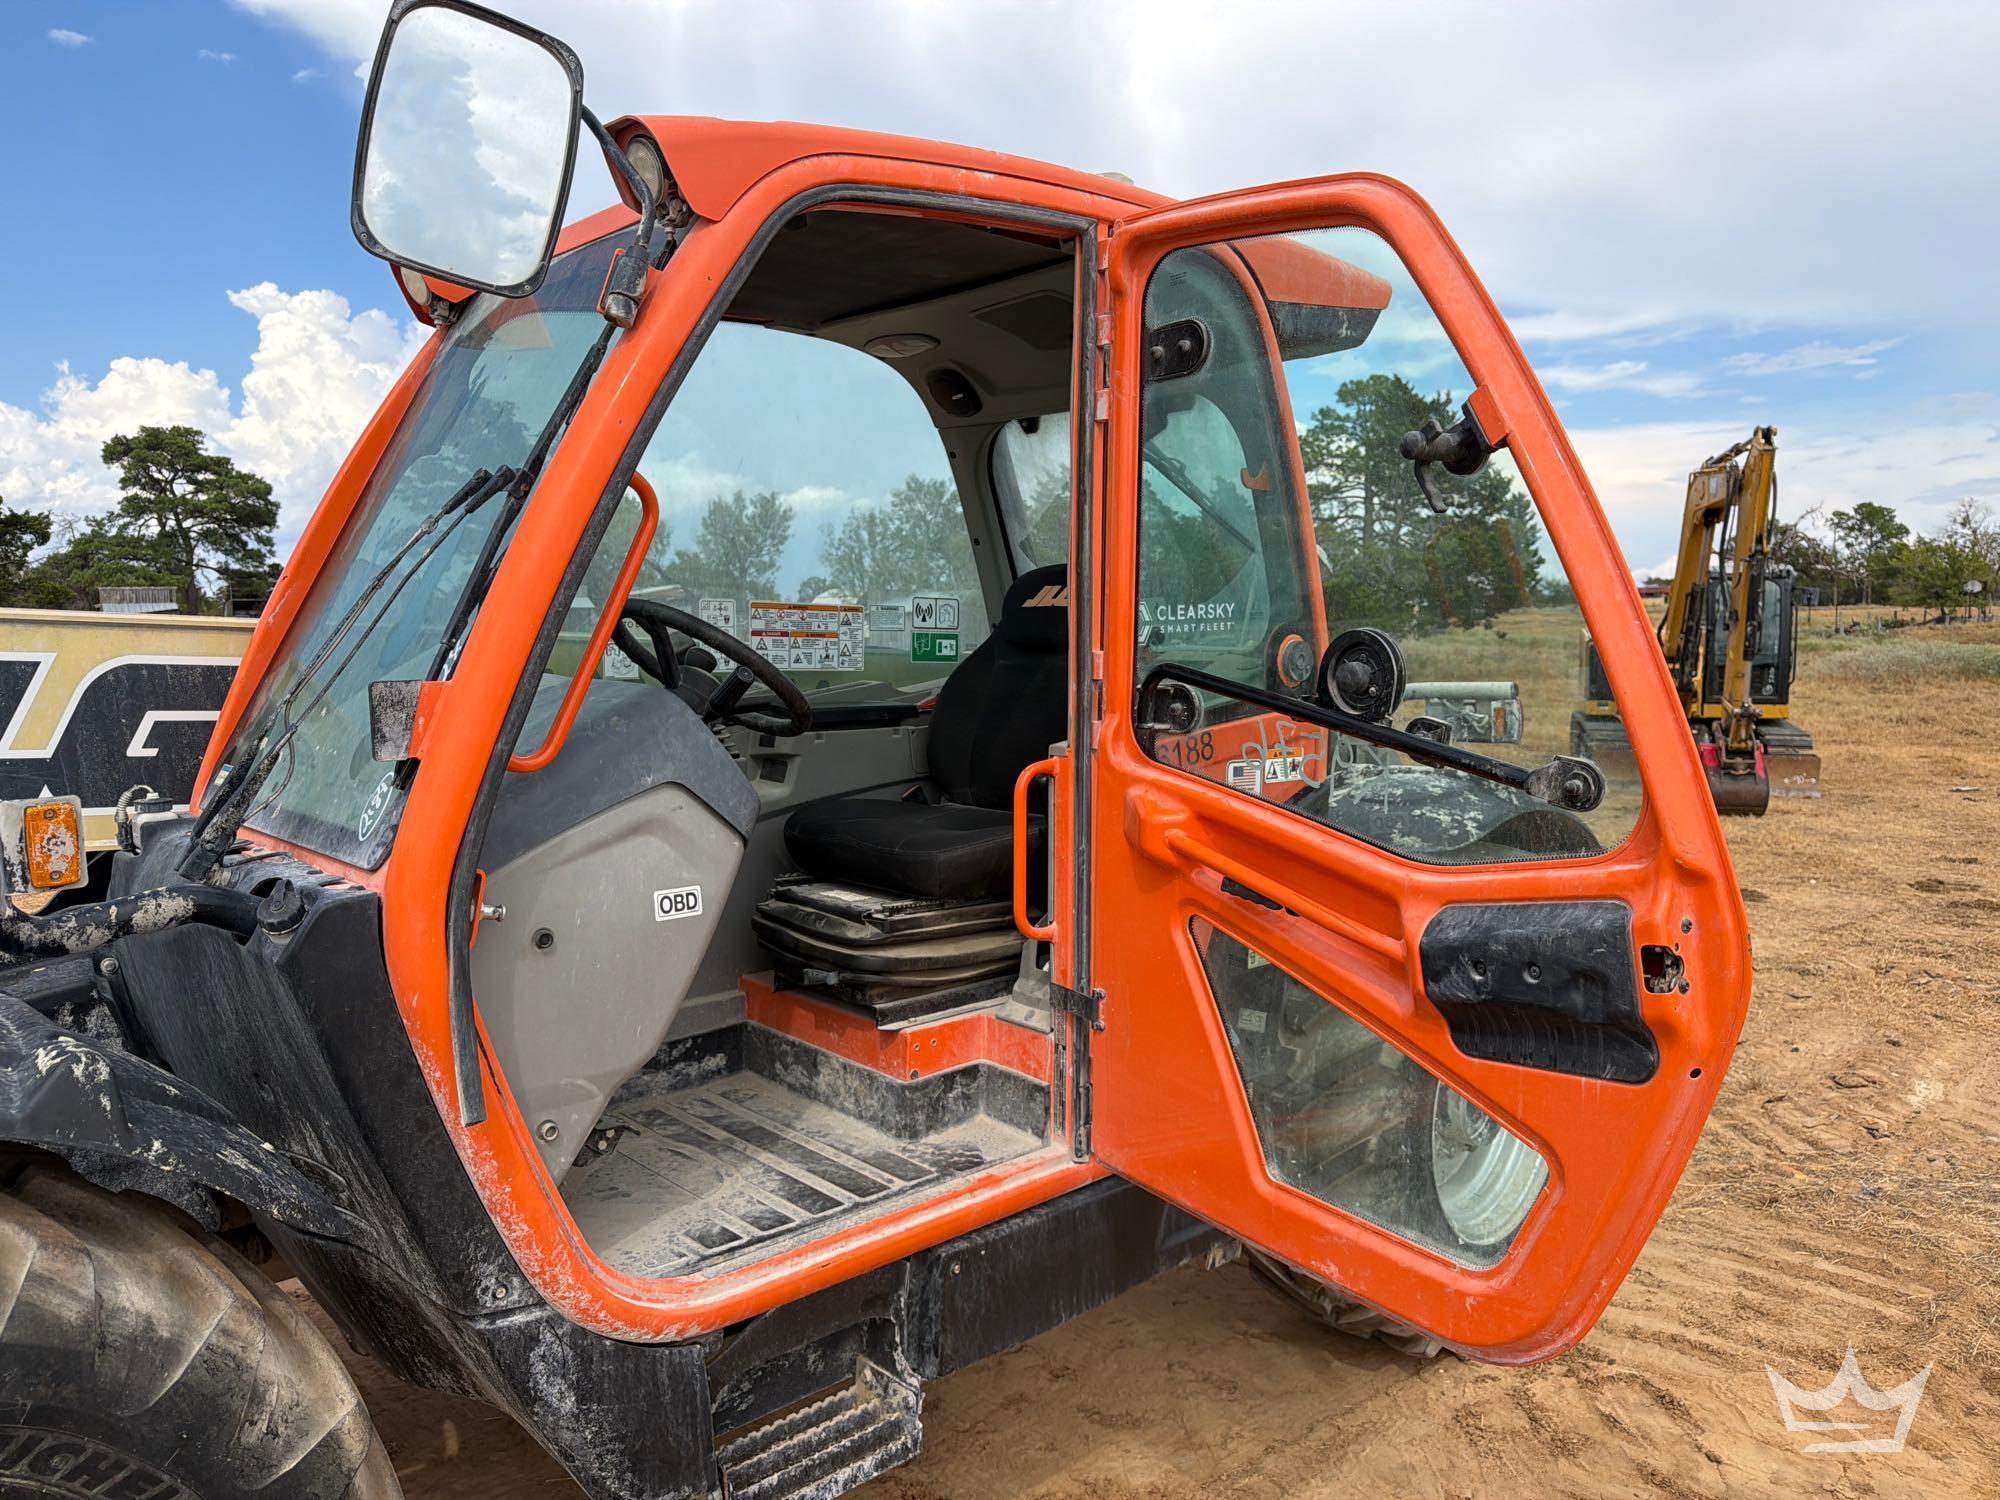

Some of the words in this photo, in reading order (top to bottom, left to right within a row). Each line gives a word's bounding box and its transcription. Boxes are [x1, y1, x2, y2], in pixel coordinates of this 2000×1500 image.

[1157, 603, 1235, 621] CLEARSKY
[1160, 623, 1196, 634] SMART
[660, 891, 698, 915] OBD
